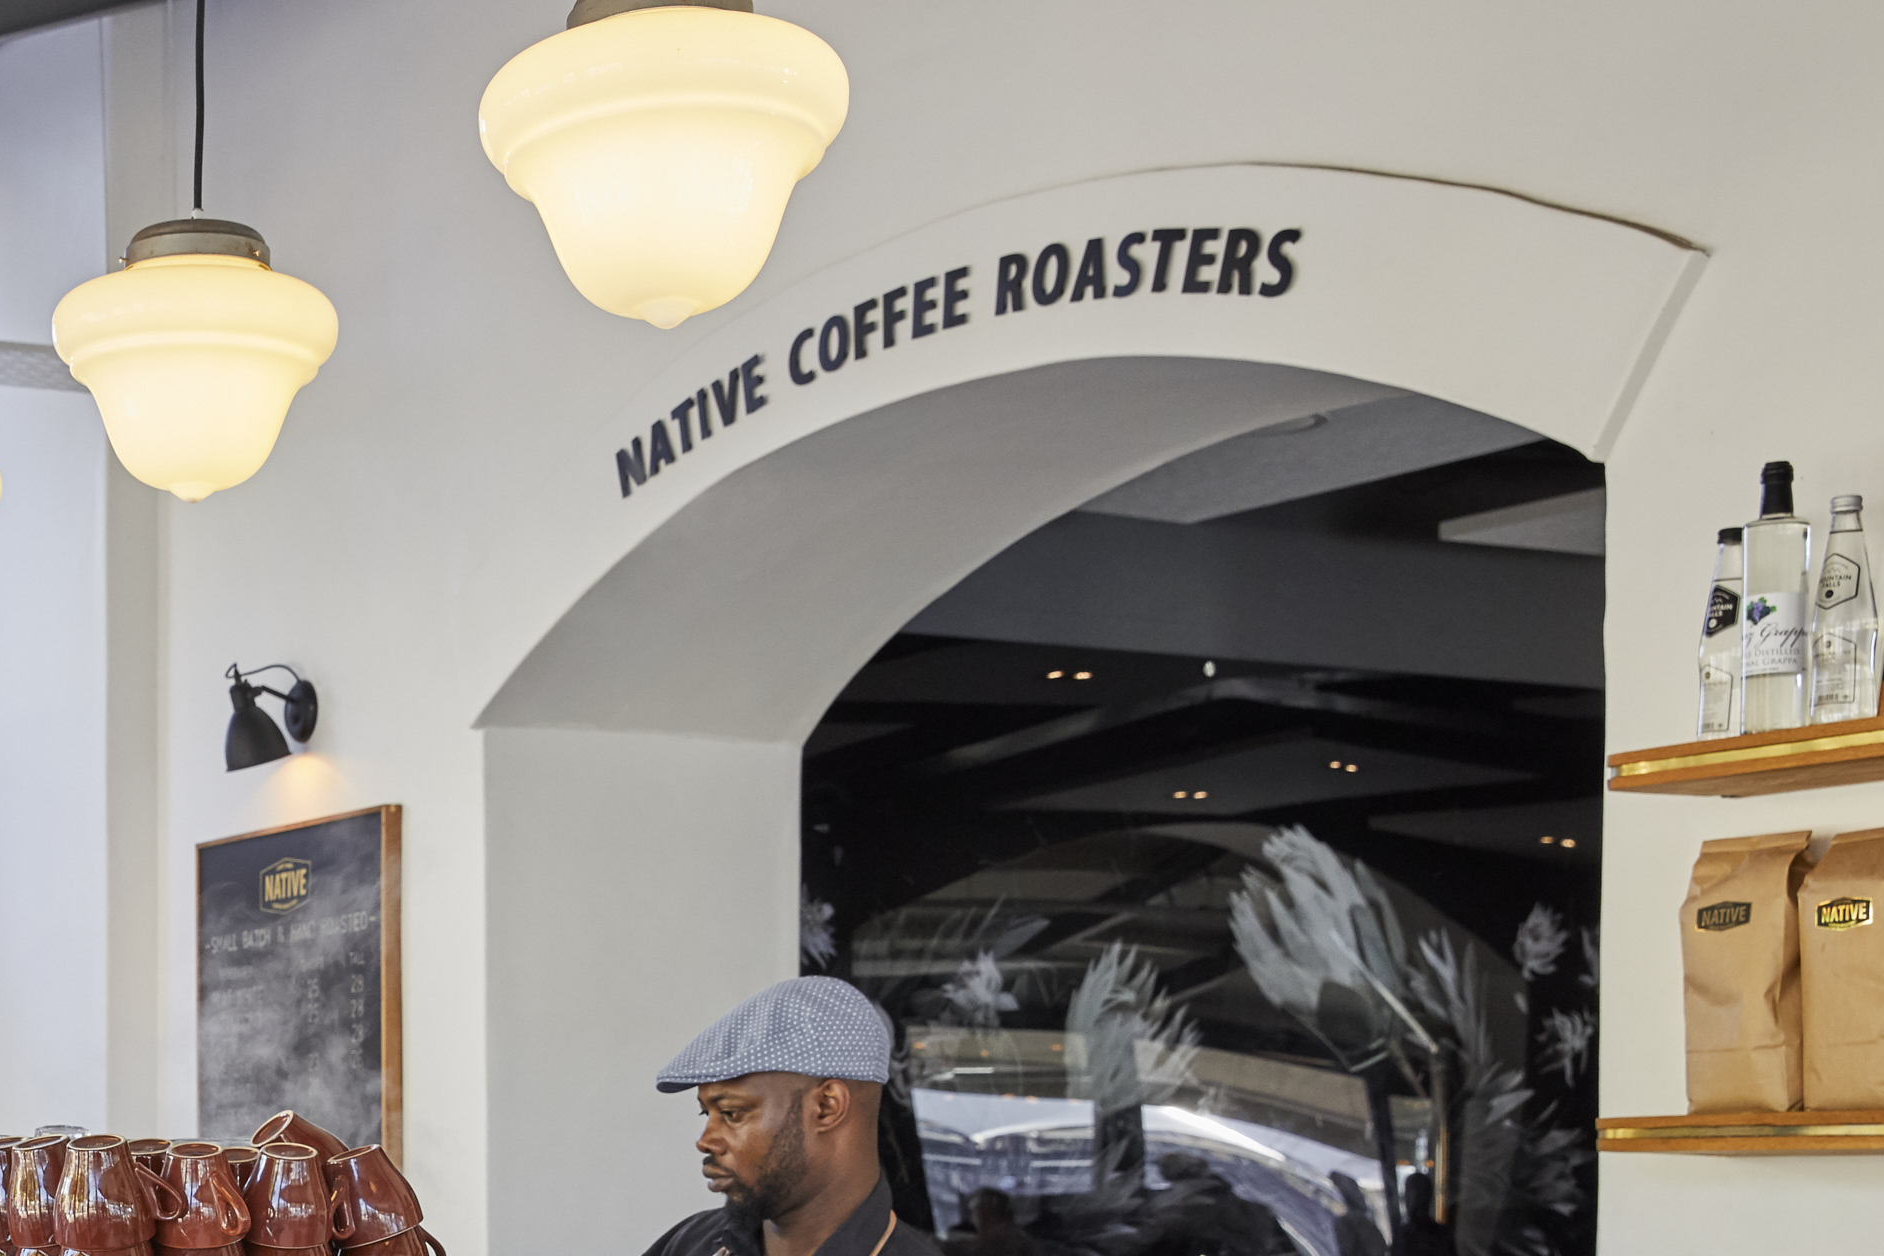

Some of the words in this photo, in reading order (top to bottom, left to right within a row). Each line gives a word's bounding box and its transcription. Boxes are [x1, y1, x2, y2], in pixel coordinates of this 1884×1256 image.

[614, 352, 770, 499] NATIVE
[788, 265, 973, 387] COFFEE
[995, 226, 1302, 317] ROASTERS
[1761, 657, 1797, 666] GRAPPA
[265, 868, 308, 902] NATIVE
[1702, 906, 1747, 926] NATIVE
[1821, 902, 1867, 924] NATIVE
